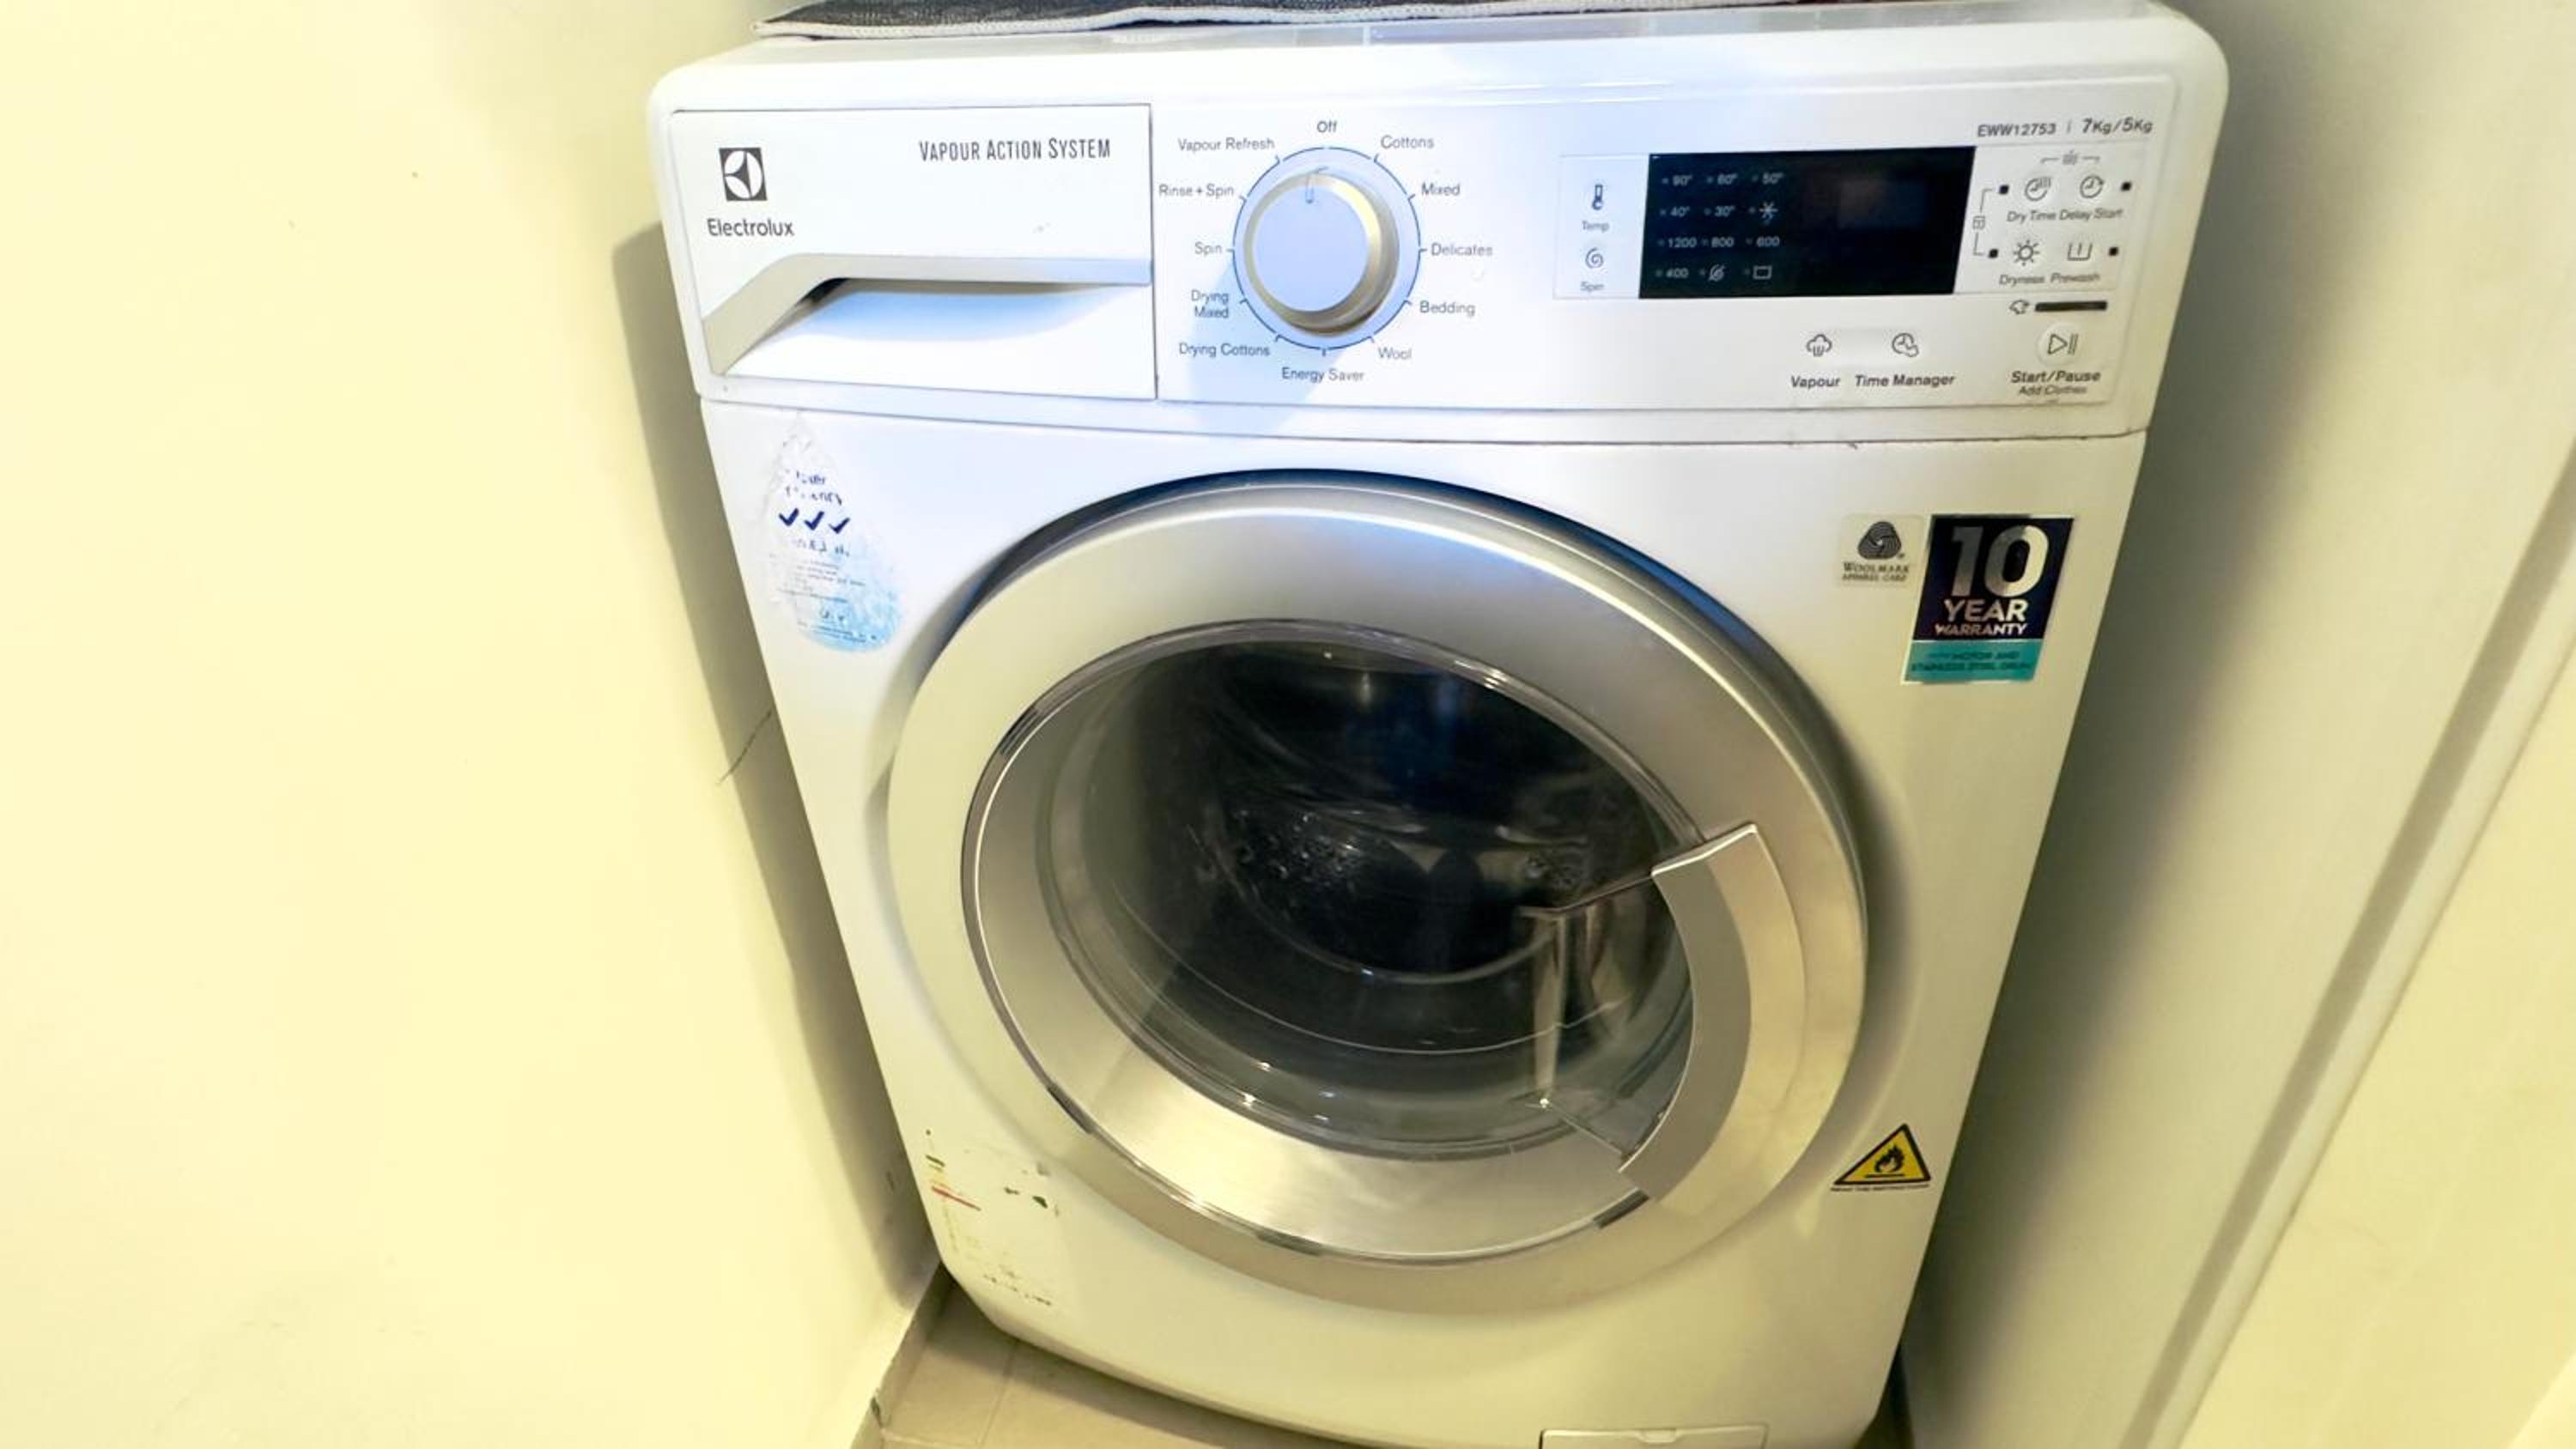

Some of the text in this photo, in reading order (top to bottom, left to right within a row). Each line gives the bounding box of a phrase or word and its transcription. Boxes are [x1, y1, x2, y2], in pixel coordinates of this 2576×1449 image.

[1317, 121, 1338, 133] Off
[1978, 123, 2057, 137] EWW12753
[920, 137, 1111, 161] VAPOUR ACTION SYSTEM
[1178, 136, 1275, 152] Vapour Refresh
[1381, 136, 1435, 149] Cottons
[1158, 185, 1194, 197] Rinse
[1206, 185, 1235, 200] Spin
[1422, 183, 1461, 197] Mixed
[2006, 210, 2057, 224] Dry Time
[2059, 208, 2123, 221] Delay Start
[708, 218, 795, 238] Electrolux
[1582, 220, 1609, 232] Temp
[1194, 242, 1223, 258] Spin
[1431, 243, 1493, 257] Delicates
[1581, 281, 1604, 292] Spin
[1191, 290, 1229, 306] Drying
[1194, 306, 1230, 318] Mixed
[1420, 301, 1475, 318] Bedding
[1179, 343, 1271, 361] Drying Cottons
[1378, 347, 1413, 361] Wool
[1282, 367, 1364, 383] Energy Saver
[1790, 375, 1840, 389] Vapour
[1855, 373, 1956, 389] Time Manager
[2011, 370, 2101, 384] Start/Pause
[1951, 524, 2050, 597] 10
[1943, 599, 2029, 622] YEAR
[1935, 623, 2028, 635] WARRANTY
